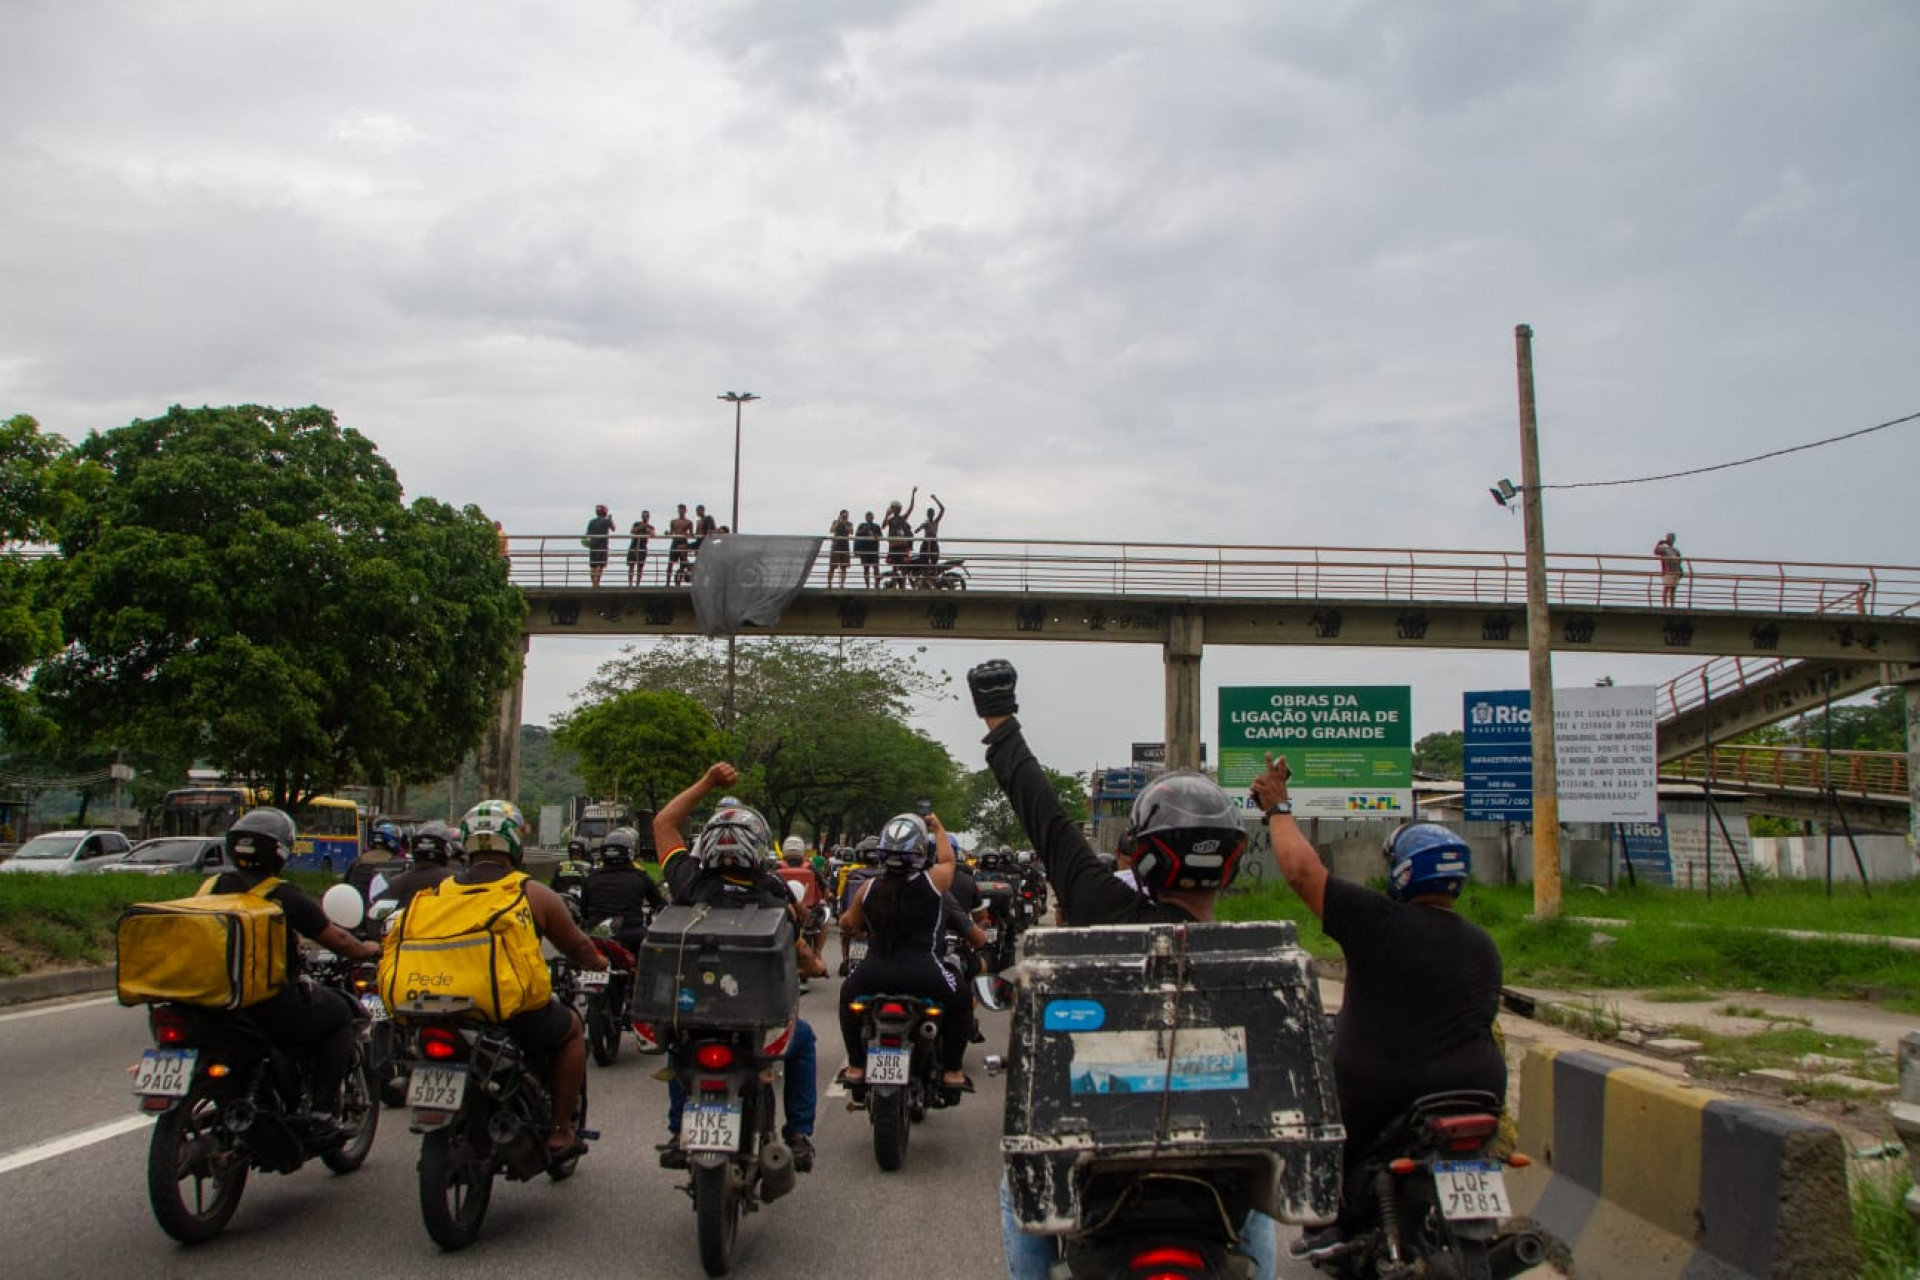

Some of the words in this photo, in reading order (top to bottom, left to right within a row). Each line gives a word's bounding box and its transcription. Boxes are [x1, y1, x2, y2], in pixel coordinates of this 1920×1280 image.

[1270, 695, 1329, 706] OBRAS
[1334, 695, 1358, 706] DA
[1231, 708, 1307, 726] LIGAÇÃO
[1310, 708, 1371, 723] VIÁRIA
[1375, 711, 1399, 723] DE
[1495, 705, 1532, 724] Rio
[1244, 727, 1308, 739] CAMPO
[1311, 727, 1385, 739] GRANDE
[1634, 823, 1662, 837] Rio
[406, 971, 454, 986] Pede
